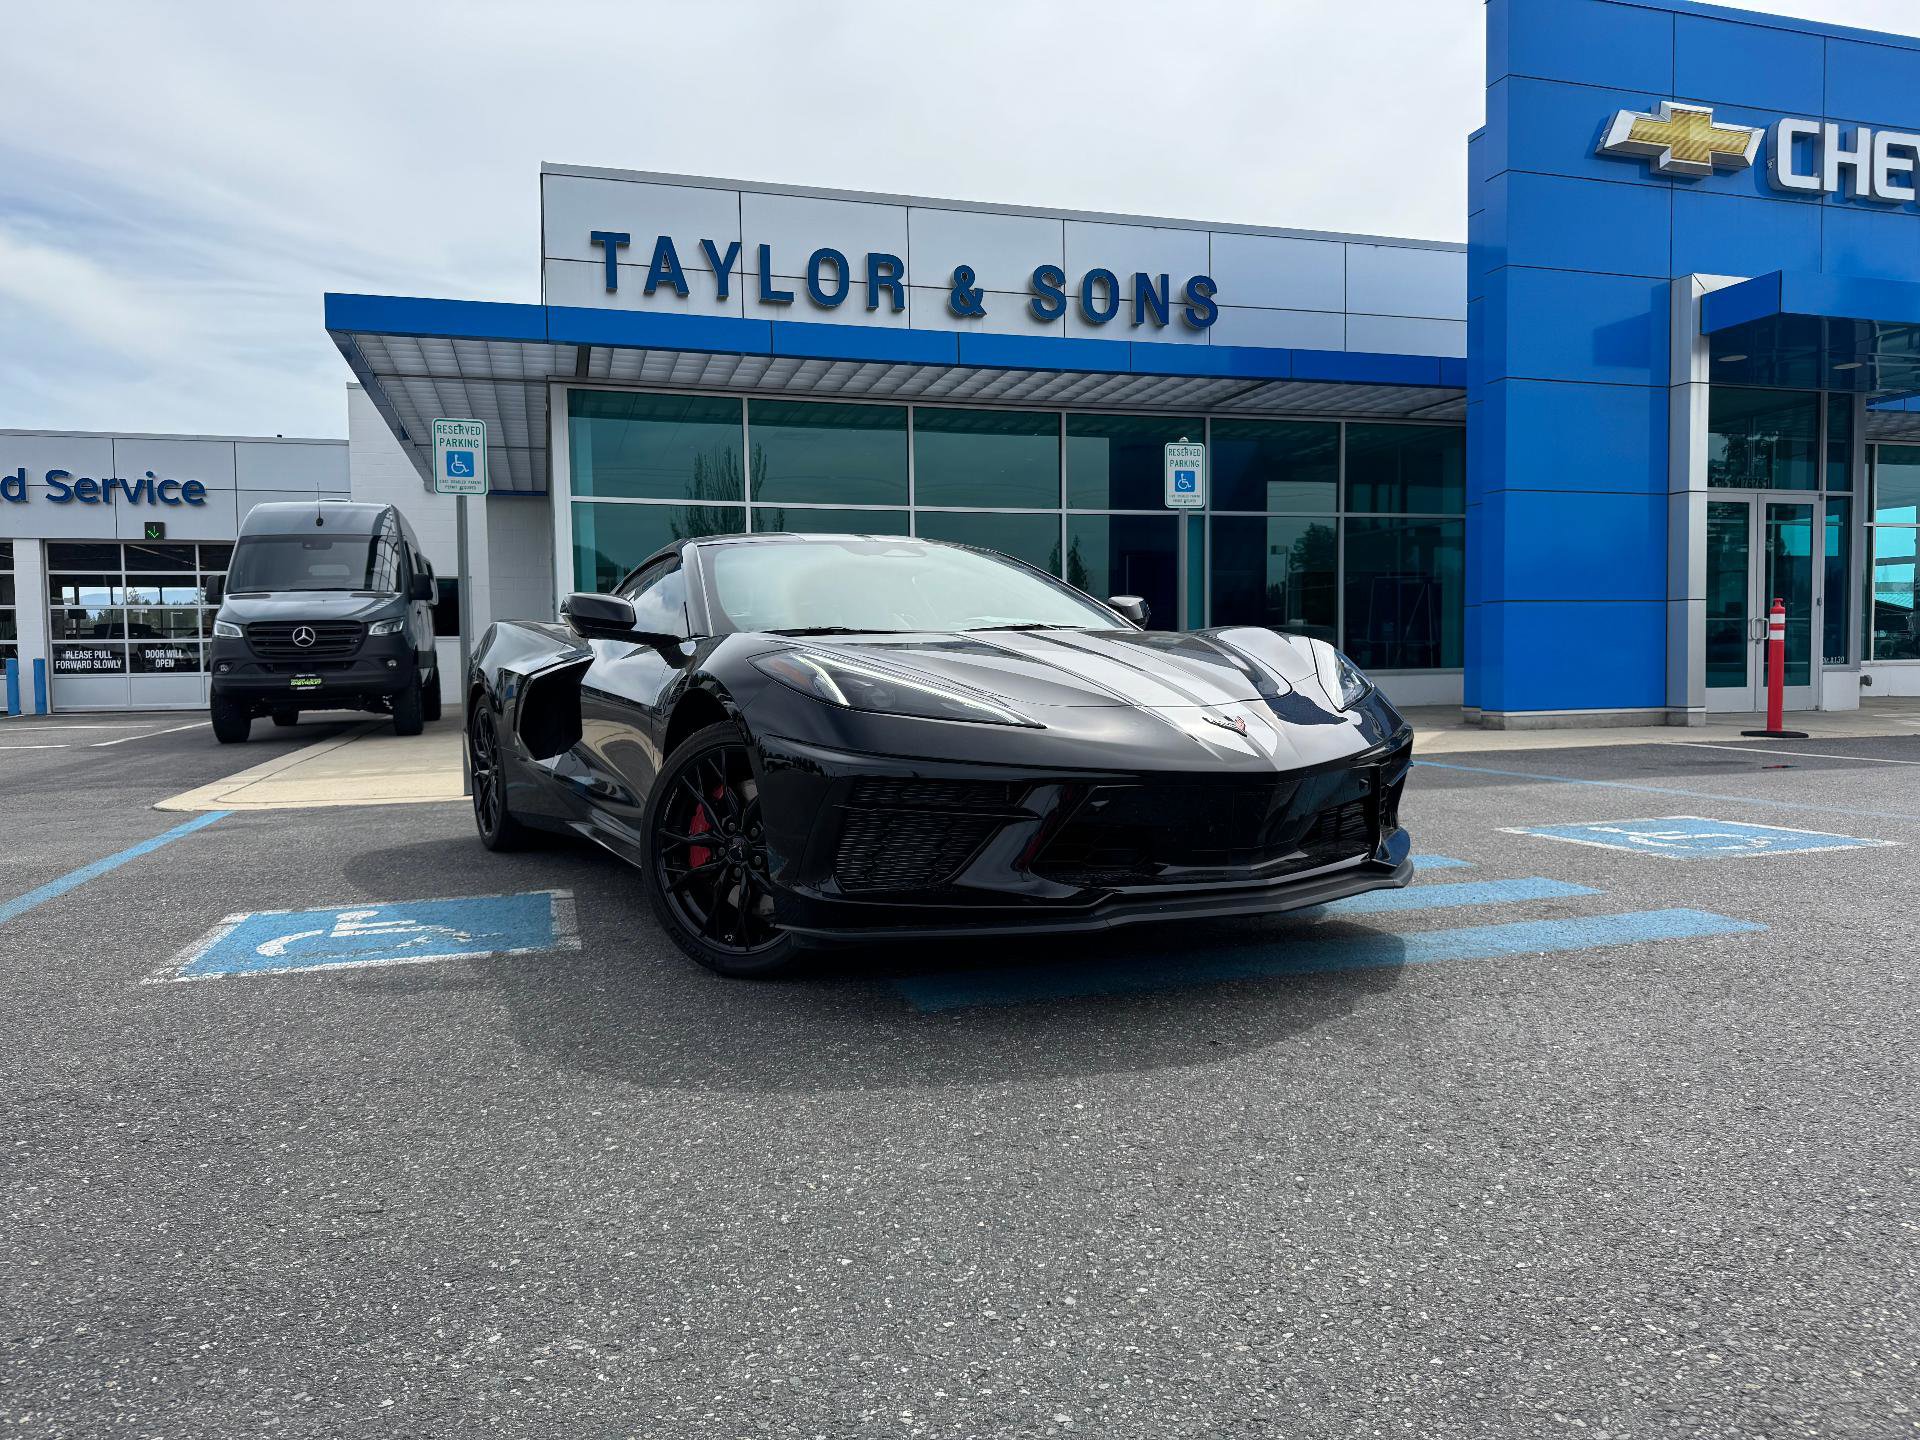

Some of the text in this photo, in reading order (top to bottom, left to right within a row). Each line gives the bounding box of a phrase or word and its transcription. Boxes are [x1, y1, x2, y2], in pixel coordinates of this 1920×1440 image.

[1770, 117, 1920, 201] CHE
[590, 231, 1220, 330] TAYLOR & SONS
[436, 424, 481, 435] RESERVED
[439, 438, 480, 449] PARKING
[1168, 447, 1201, 457] RESERVED
[1169, 459, 1200, 468] PARKING
[45, 469, 207, 505] Service
[65, 650, 112, 659] PLEASE PULL
[145, 649, 184, 658] DOOR WILL
[55, 659, 122, 670] FORWARD SLOWLY
[155, 659, 175, 668] OPEN
